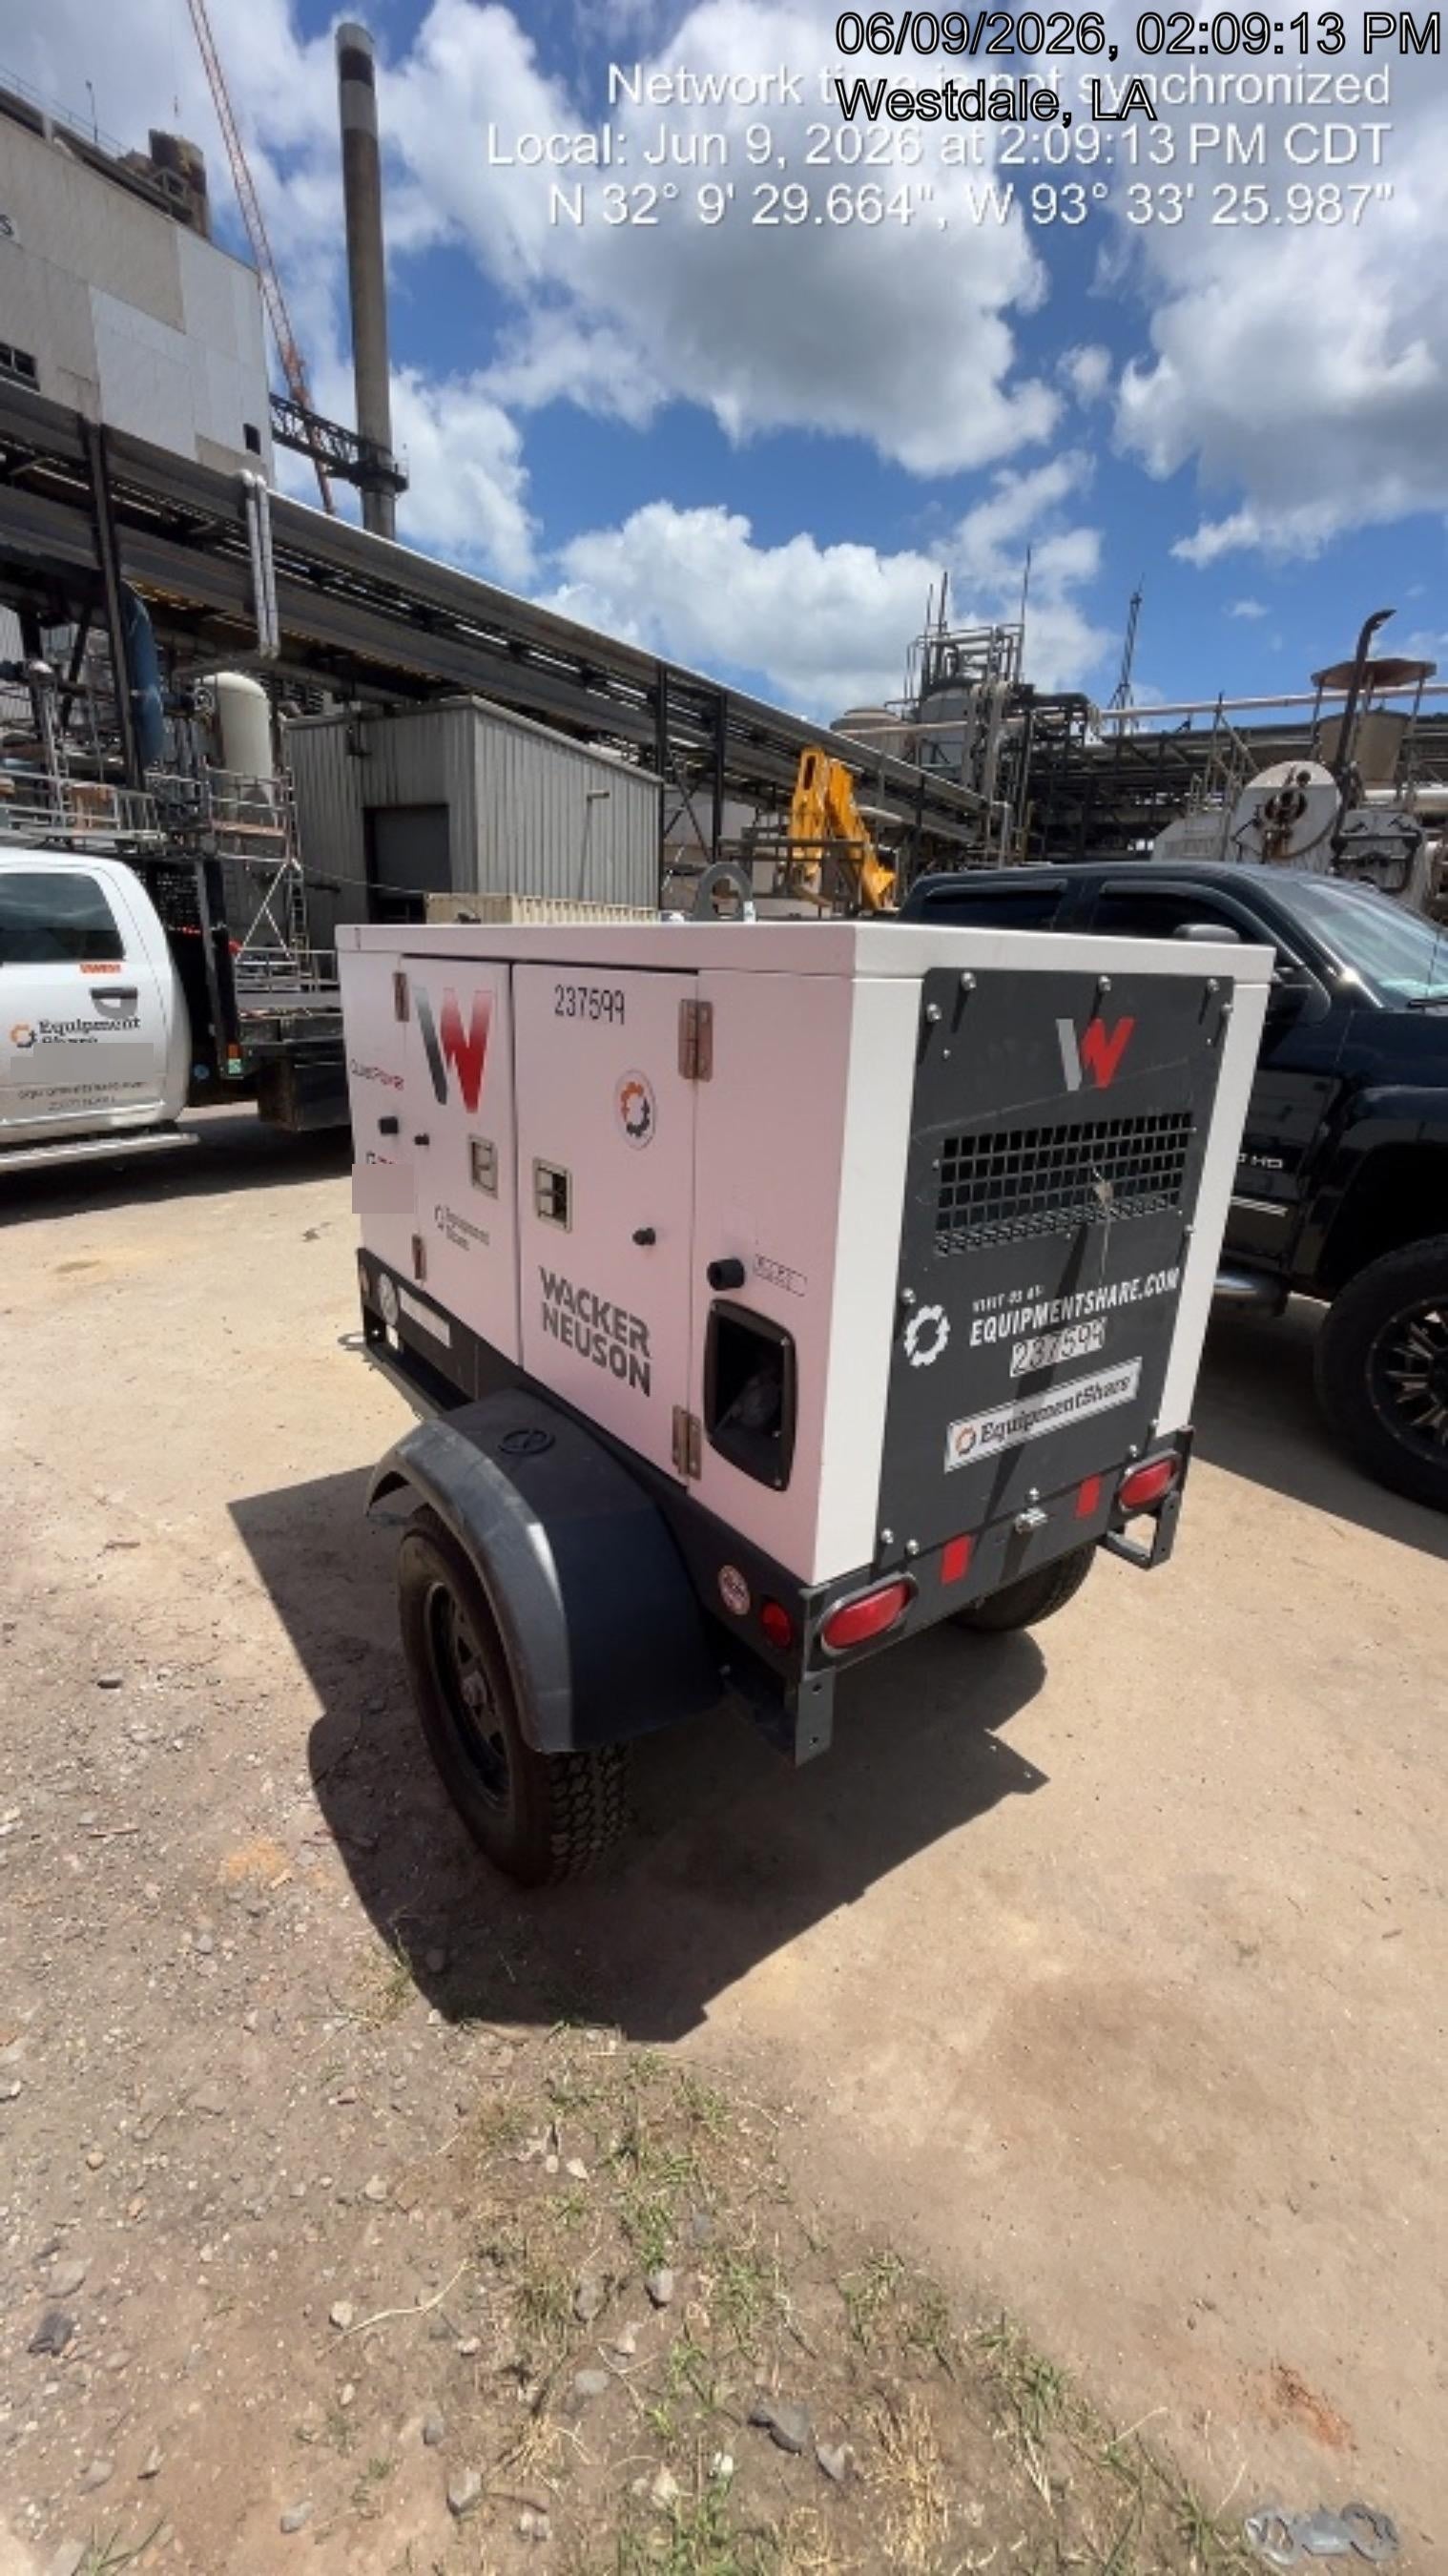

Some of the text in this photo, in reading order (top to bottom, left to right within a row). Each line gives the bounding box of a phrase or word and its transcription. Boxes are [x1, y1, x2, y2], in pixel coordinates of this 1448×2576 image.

[553, 984, 626, 1026] 237599
[537, 1265, 652, 1360] WACKER
[969, 1267, 1181, 1348] EQUIPMENTSHARE.COM
[542, 1302, 652, 1398] NEUSON
[980, 1376, 1132, 1443] EquipmentShare
